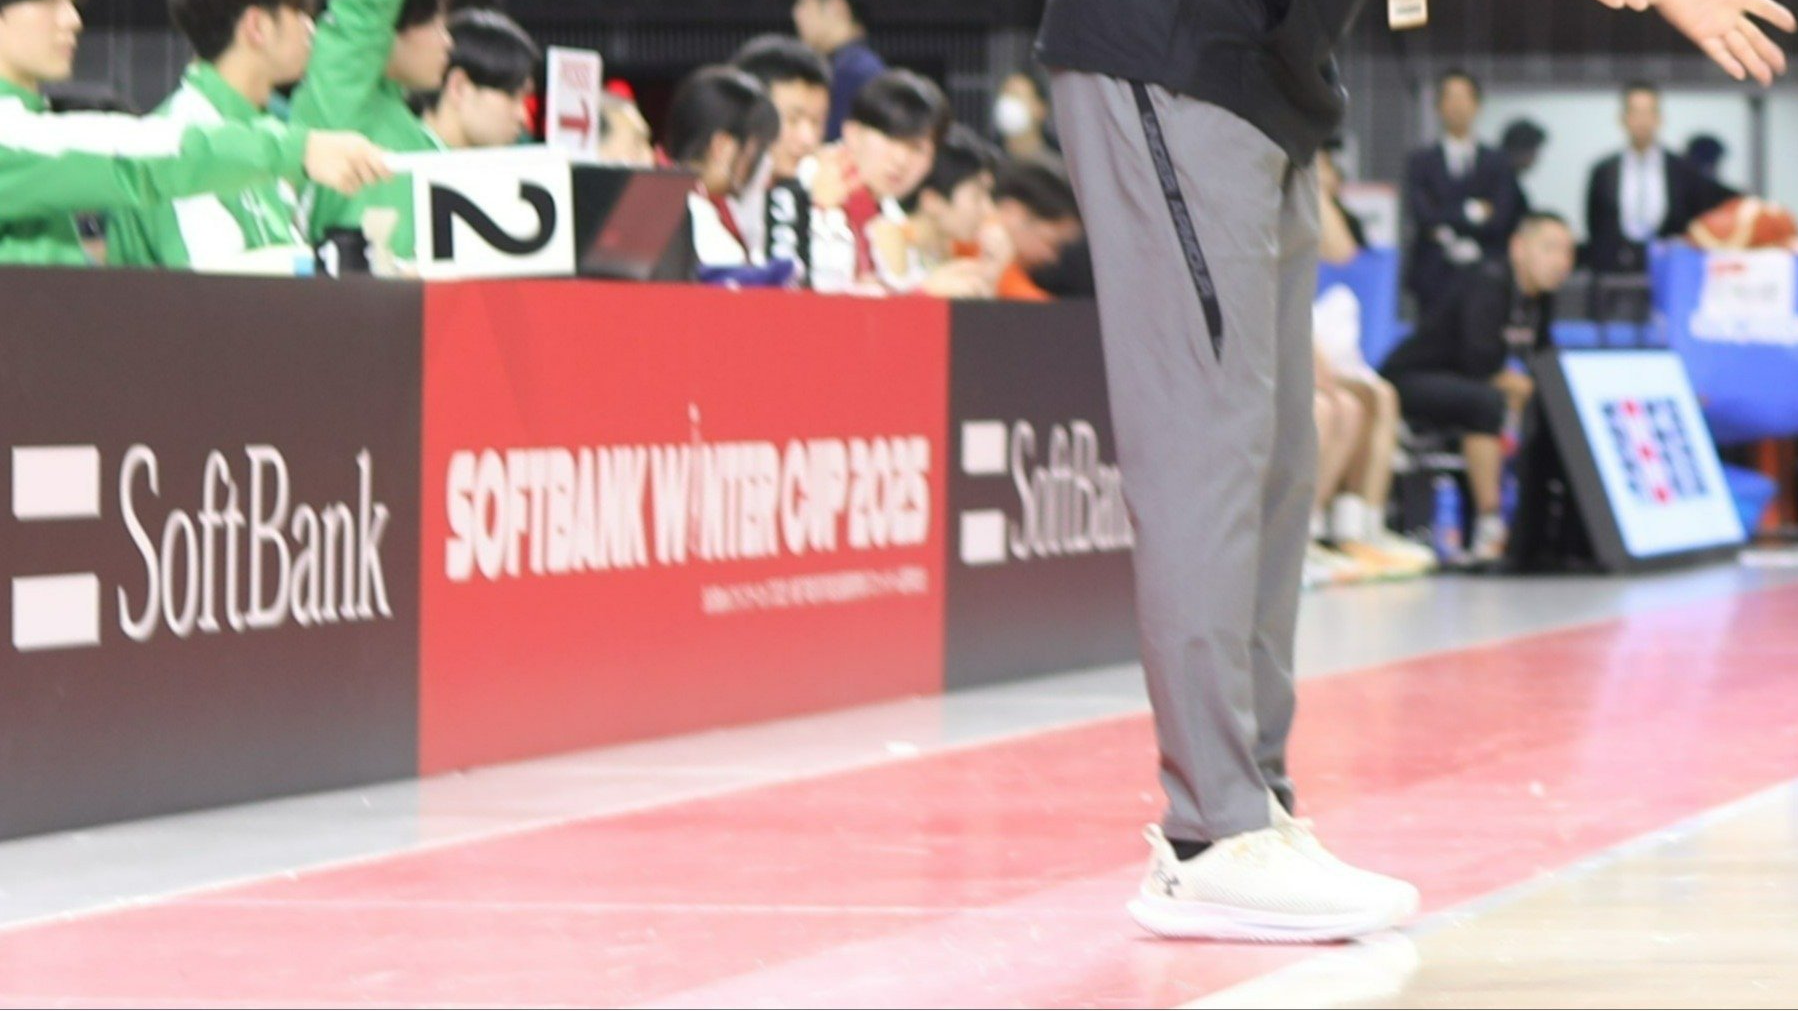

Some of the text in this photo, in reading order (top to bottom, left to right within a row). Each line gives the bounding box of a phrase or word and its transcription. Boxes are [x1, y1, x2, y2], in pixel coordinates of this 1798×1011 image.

[429, 179, 557, 260] 2
[117, 443, 392, 642] SoftBank
[444, 402, 931, 581] SOFTBANK WINTER CUP 2025
